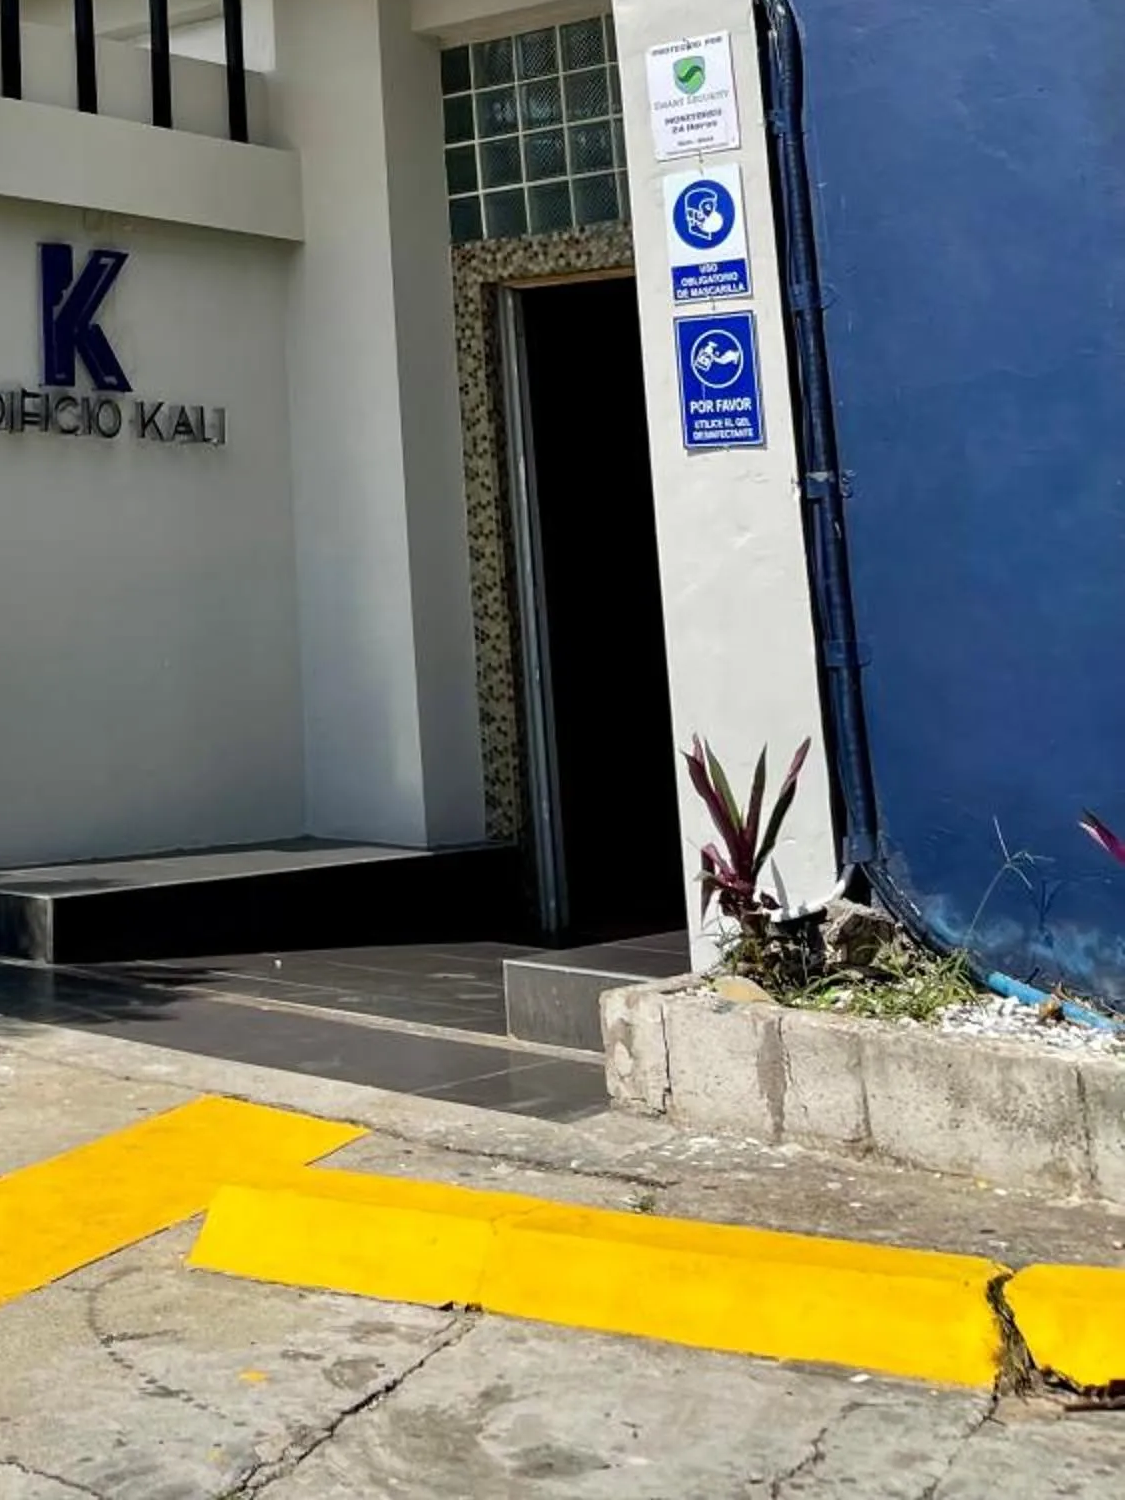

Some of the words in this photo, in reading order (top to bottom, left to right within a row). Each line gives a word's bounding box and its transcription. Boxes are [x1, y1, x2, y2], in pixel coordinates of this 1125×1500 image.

[699, 263, 718, 274] USO
[681, 271, 739, 287] OBLIGATORIO
[676, 288, 689, 299] DE
[690, 282, 746, 297] MASCARILLA
[38, 242, 131, 391] K
[690, 400, 714, 415] POR
[716, 396, 752, 413] FAVOR
